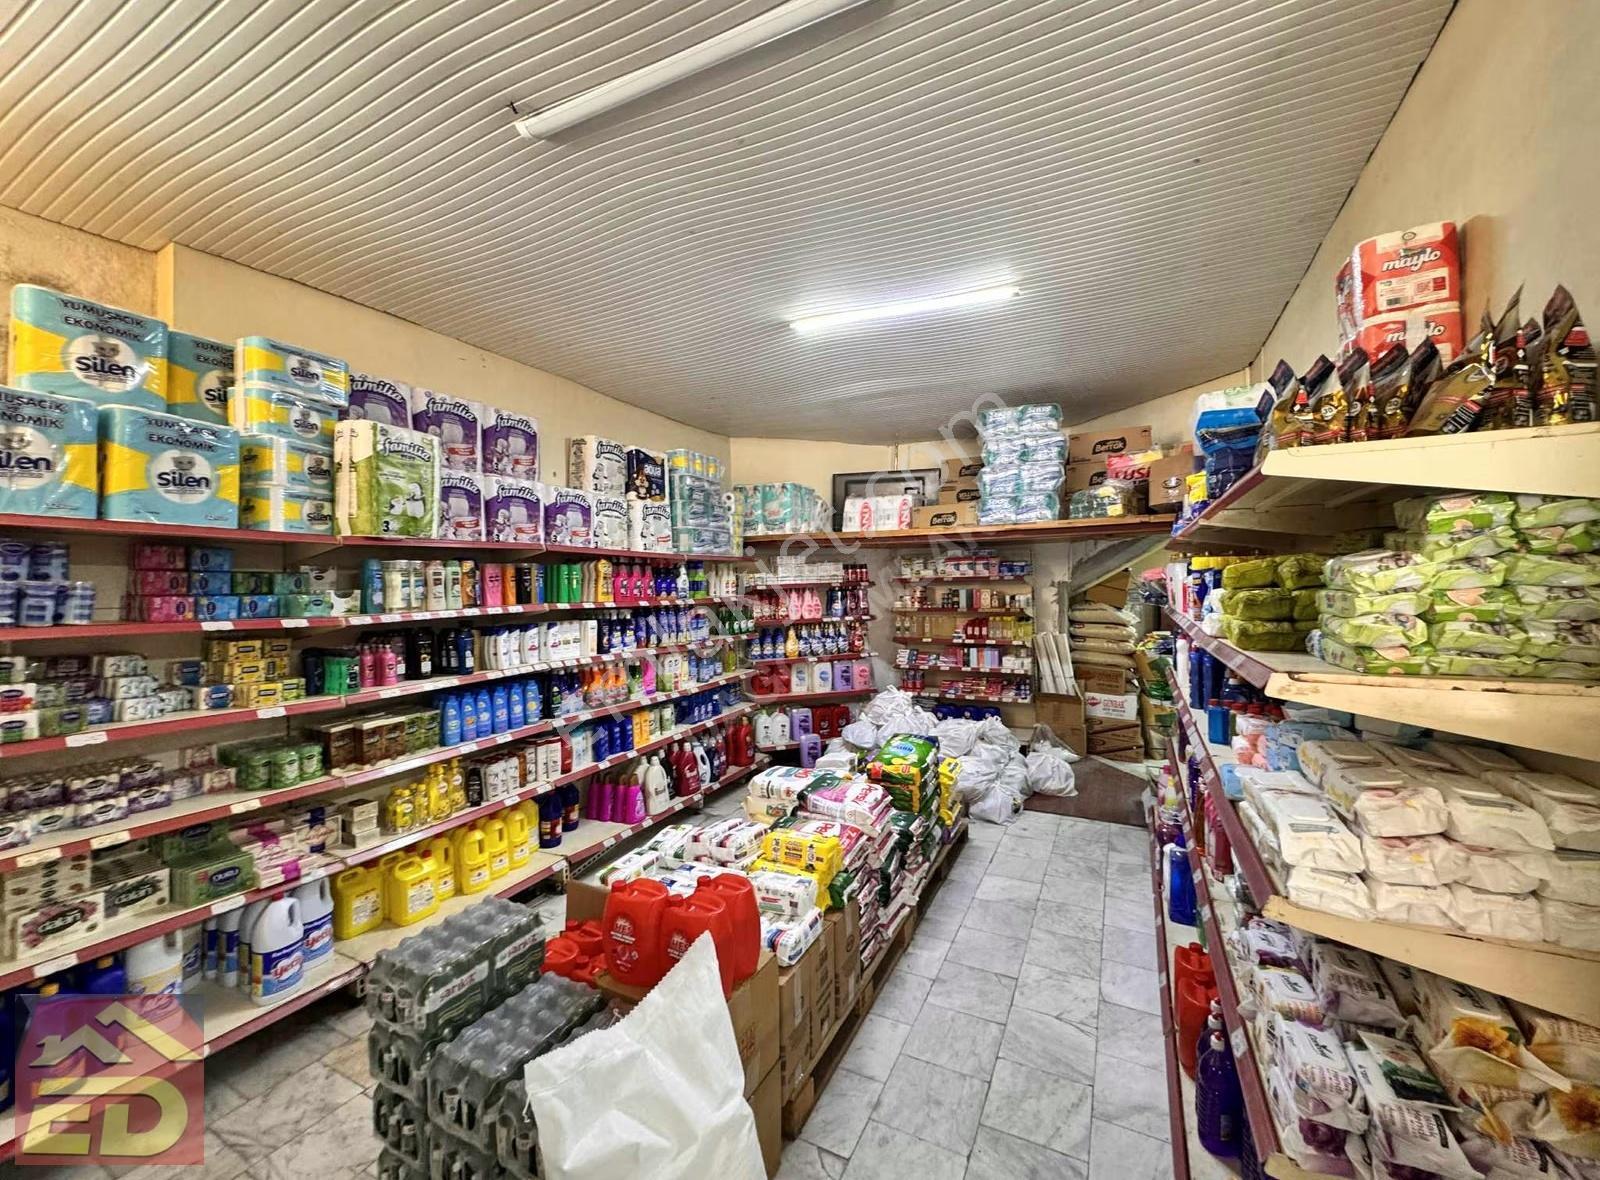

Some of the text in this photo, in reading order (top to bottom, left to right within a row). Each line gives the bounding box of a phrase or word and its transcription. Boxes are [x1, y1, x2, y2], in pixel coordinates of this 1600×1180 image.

[1382, 247, 1441, 272] maylo
[1385, 320, 1446, 342] mlo
[75, 355, 136, 378] Silen
[290, 366, 320, 380] Silen
[427, 397, 476, 422] familia
[294, 418, 319, 431] Silen
[497, 414, 537, 436] familia
[382, 437, 432, 462] familia
[157, 470, 211, 488] Silen
[441, 474, 480, 494] amilia
[497, 484, 539, 503] familia
